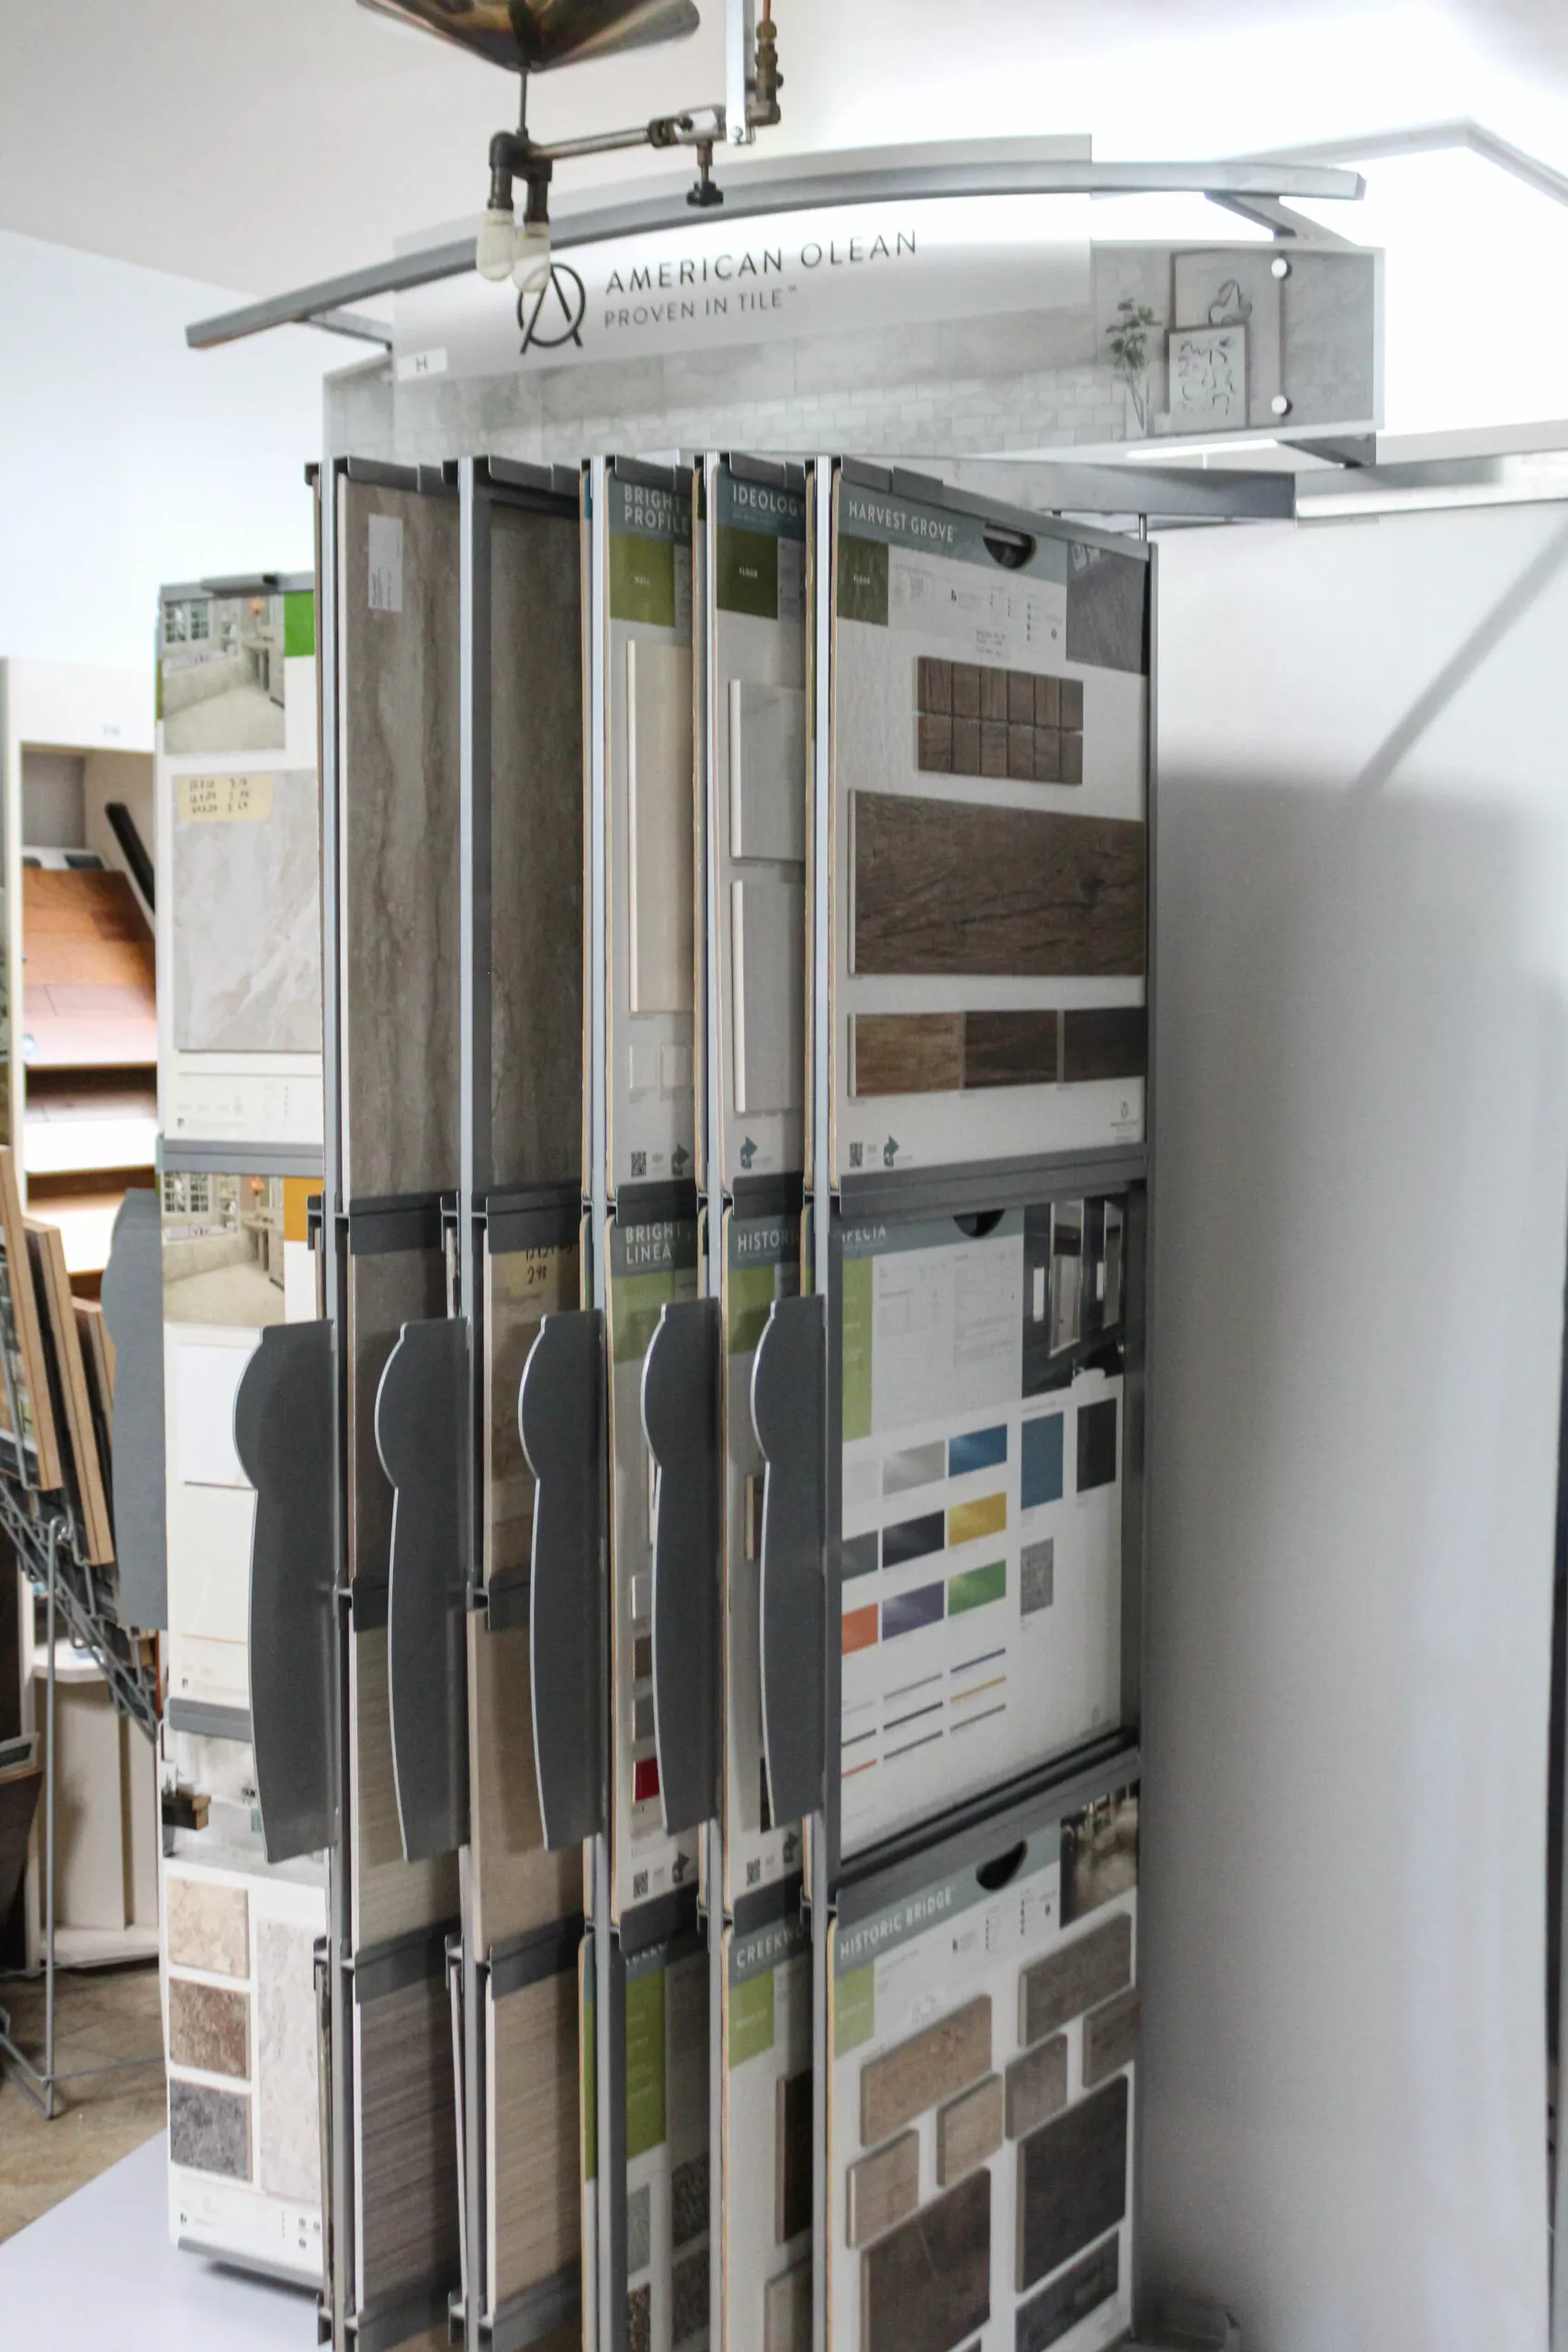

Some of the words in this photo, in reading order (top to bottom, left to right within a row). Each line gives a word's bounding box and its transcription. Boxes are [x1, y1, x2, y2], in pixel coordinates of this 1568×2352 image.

[604, 247, 783, 296] AMERICAN
[799, 229, 917, 270] OLEAN
[604, 299, 695, 329] PROVEN
[705, 295, 728, 315] IN
[849, 499, 907, 532] HARVEST
[910, 515, 954, 543] GROVE
[626, 1242, 672, 1265] LINEA
[840, 1913, 902, 1961] HISTORIC
[905, 1885, 953, 1928] BRIDGE
